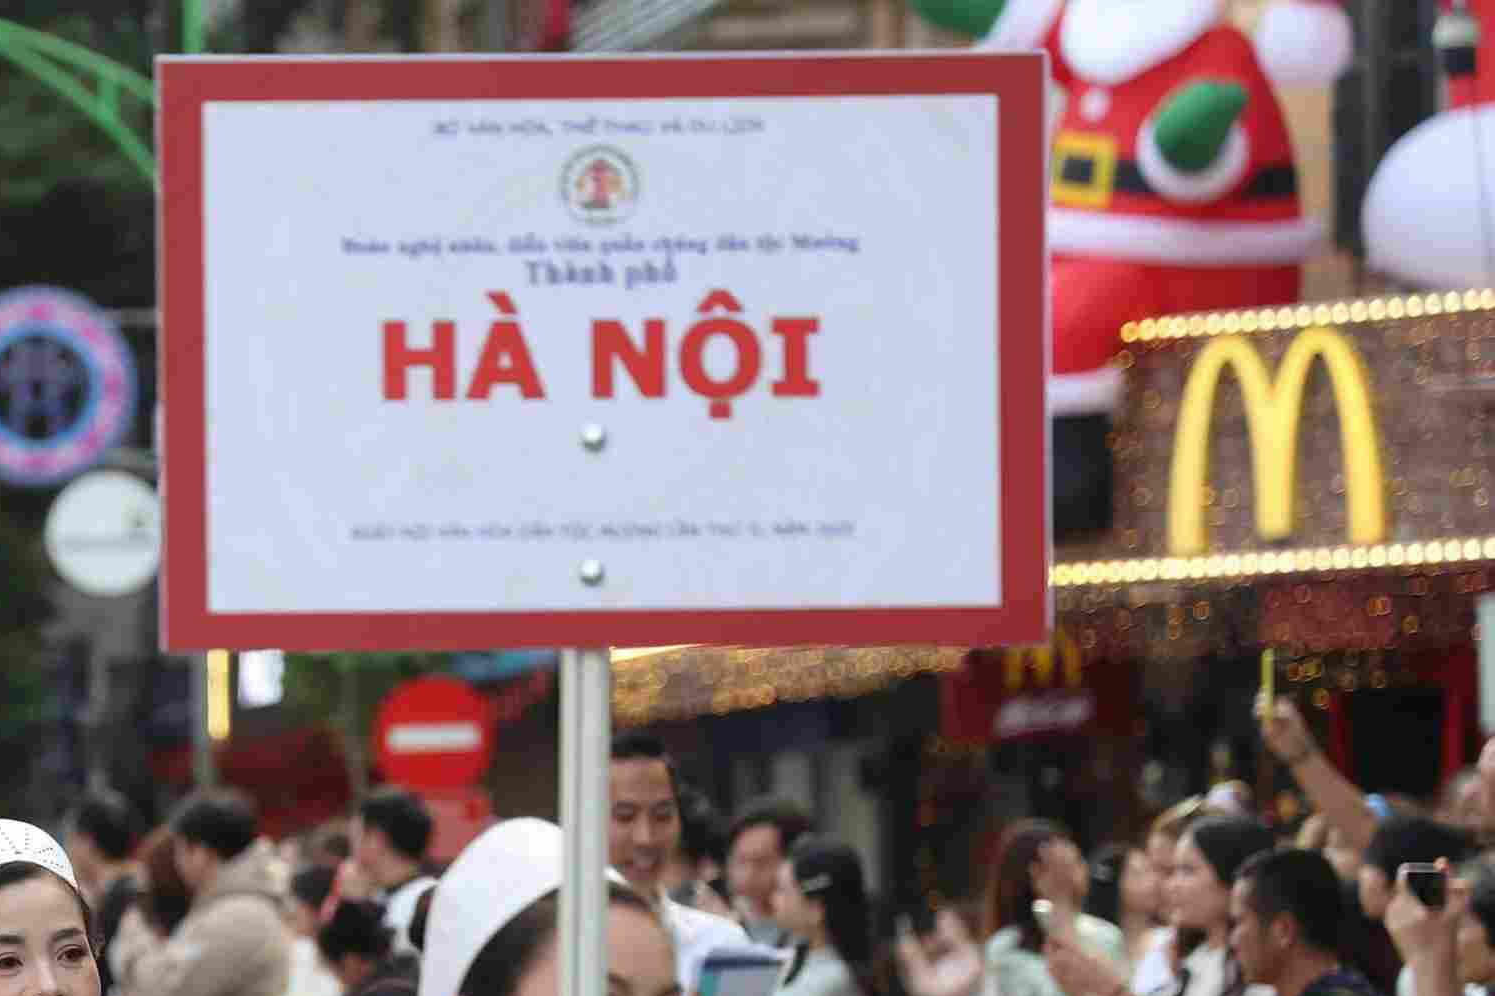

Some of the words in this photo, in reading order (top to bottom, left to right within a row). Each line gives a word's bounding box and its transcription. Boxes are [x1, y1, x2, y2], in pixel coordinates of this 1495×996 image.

[524, 259, 615, 286] Thành
[625, 253, 679, 291] phố
[382, 291, 547, 401] HÀ
[590, 289, 821, 420] NỘI
